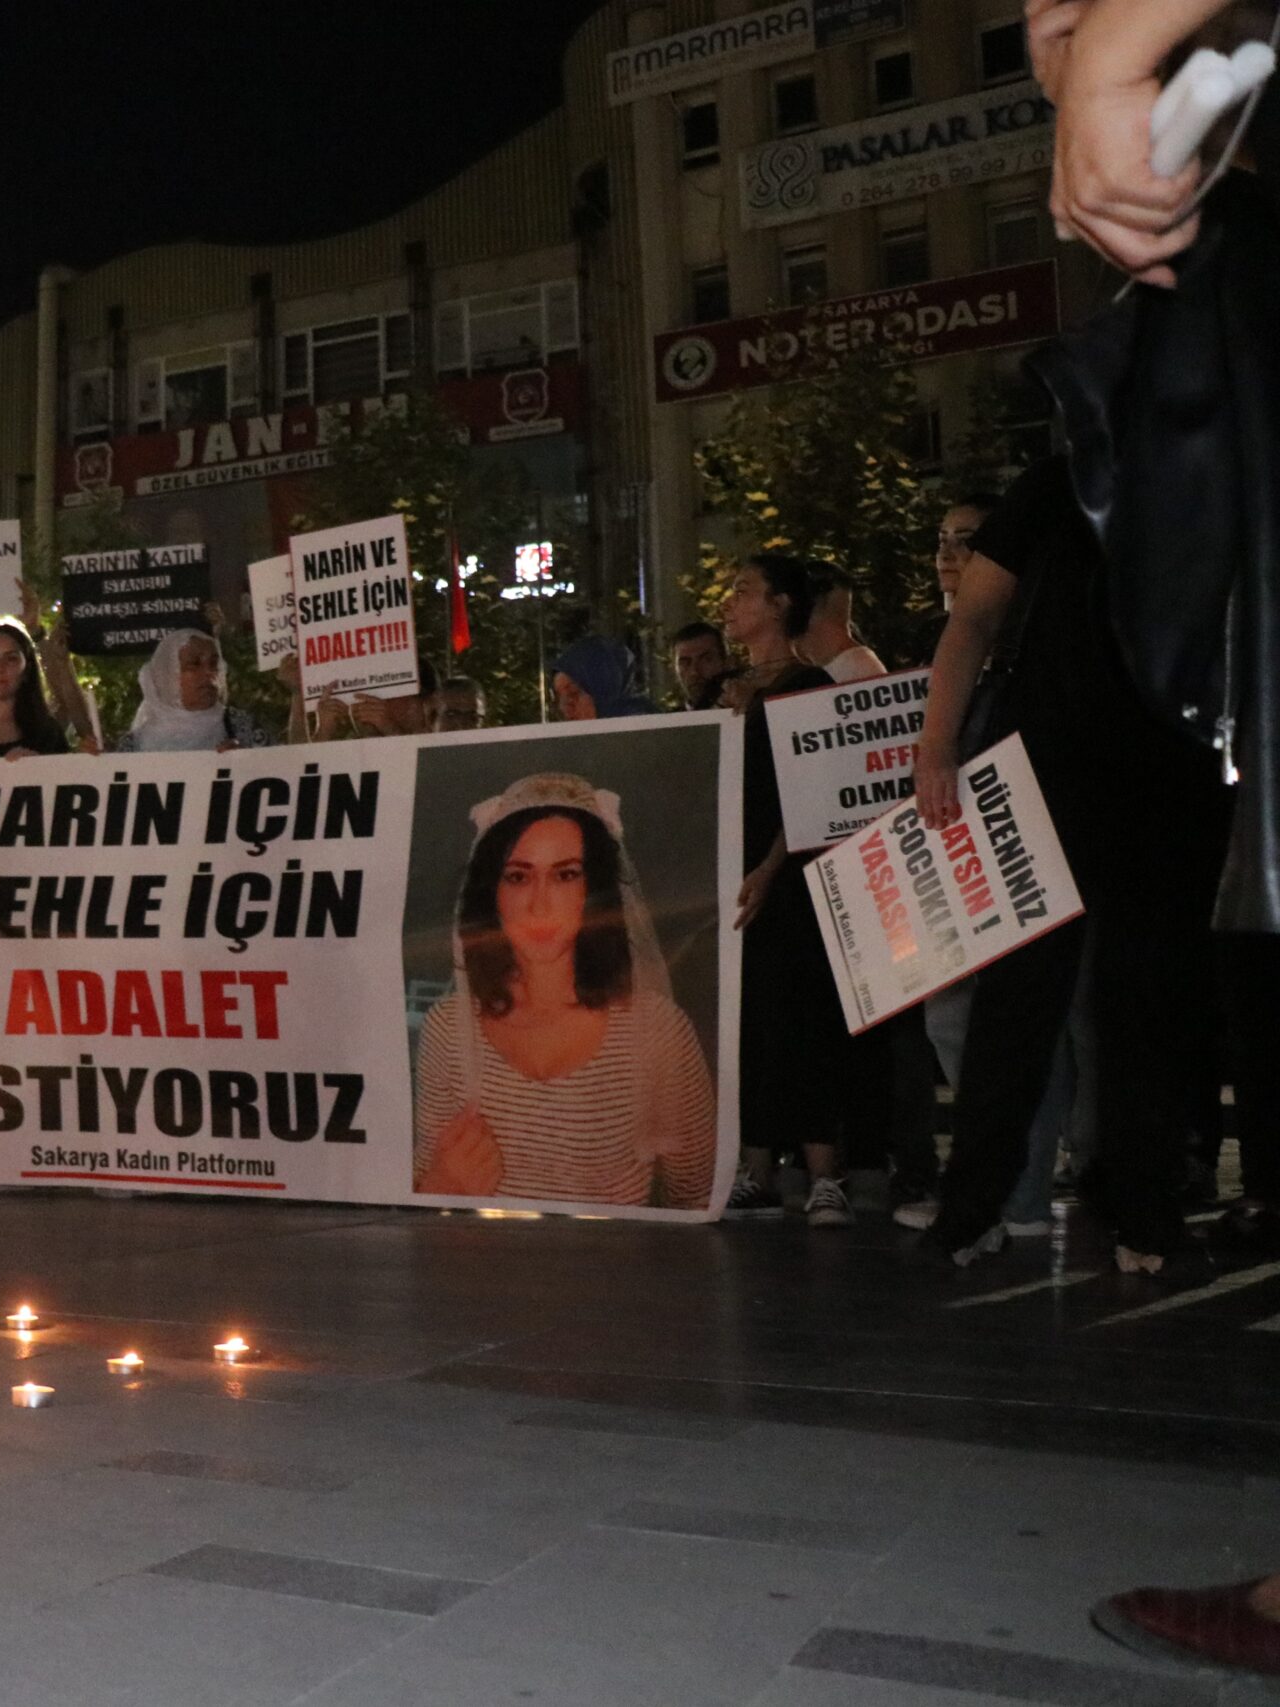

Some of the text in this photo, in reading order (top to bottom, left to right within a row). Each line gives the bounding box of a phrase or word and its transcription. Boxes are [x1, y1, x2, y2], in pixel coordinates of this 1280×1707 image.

[633, 6, 810, 75] MARMARA
[841, 191, 855, 206] 0
[881, 290, 1020, 342] ODASI
[302, 536, 397, 582] NARİN VE
[299, 575, 409, 625] SEHLE İÇİN
[305, 620, 409, 667] ADALET!!!!
[204, 763, 380, 857] İÇİN
[938, 818, 996, 918] ATSIN
[968, 762, 1049, 929] DÜZENİNİZ
[183, 859, 364, 954] İÇİN
[822, 858, 846, 911] Sakarya
[837, 911, 856, 951] Kadın
[4, 968, 289, 1041] ADALET
[30, 1145, 276, 1177] Sakarya Kadın Platformu
